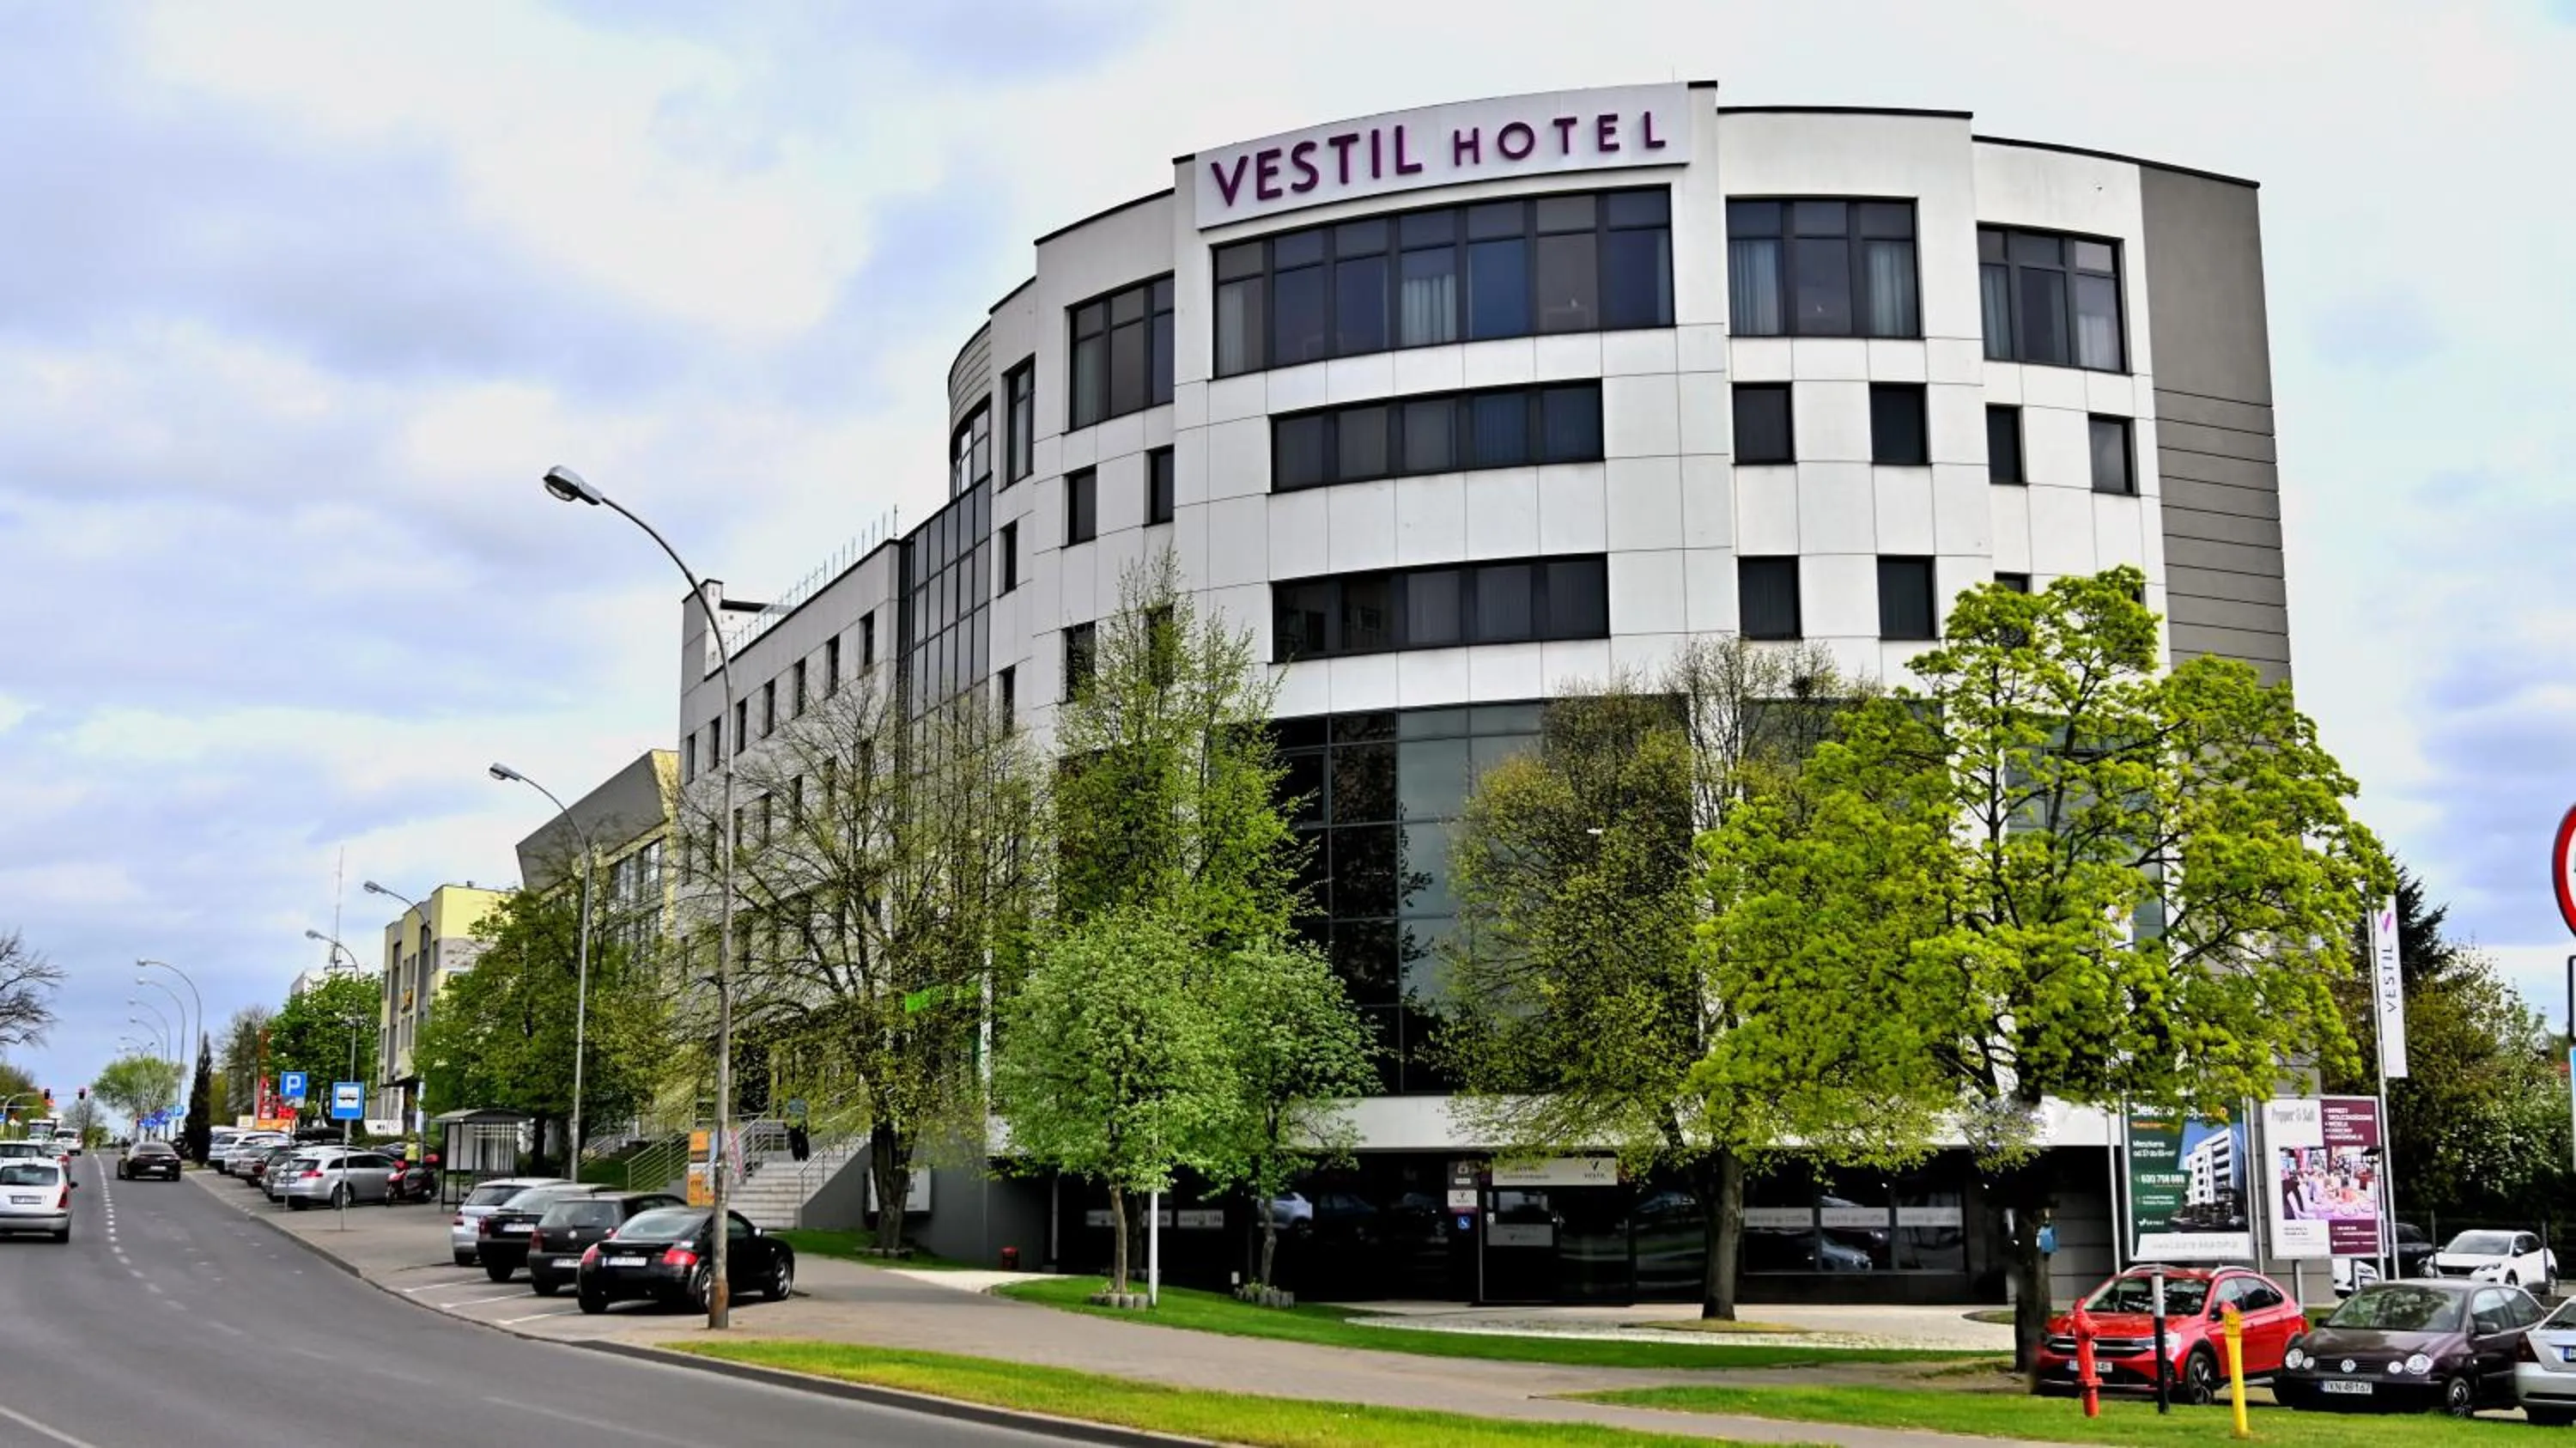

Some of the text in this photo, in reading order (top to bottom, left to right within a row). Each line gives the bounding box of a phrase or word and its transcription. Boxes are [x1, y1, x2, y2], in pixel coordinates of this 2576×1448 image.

[1211, 111, 1666, 206] VESTIL HOTEL
[2381, 945, 2397, 1013] VESTIL
[286, 1075, 301, 1094] P
